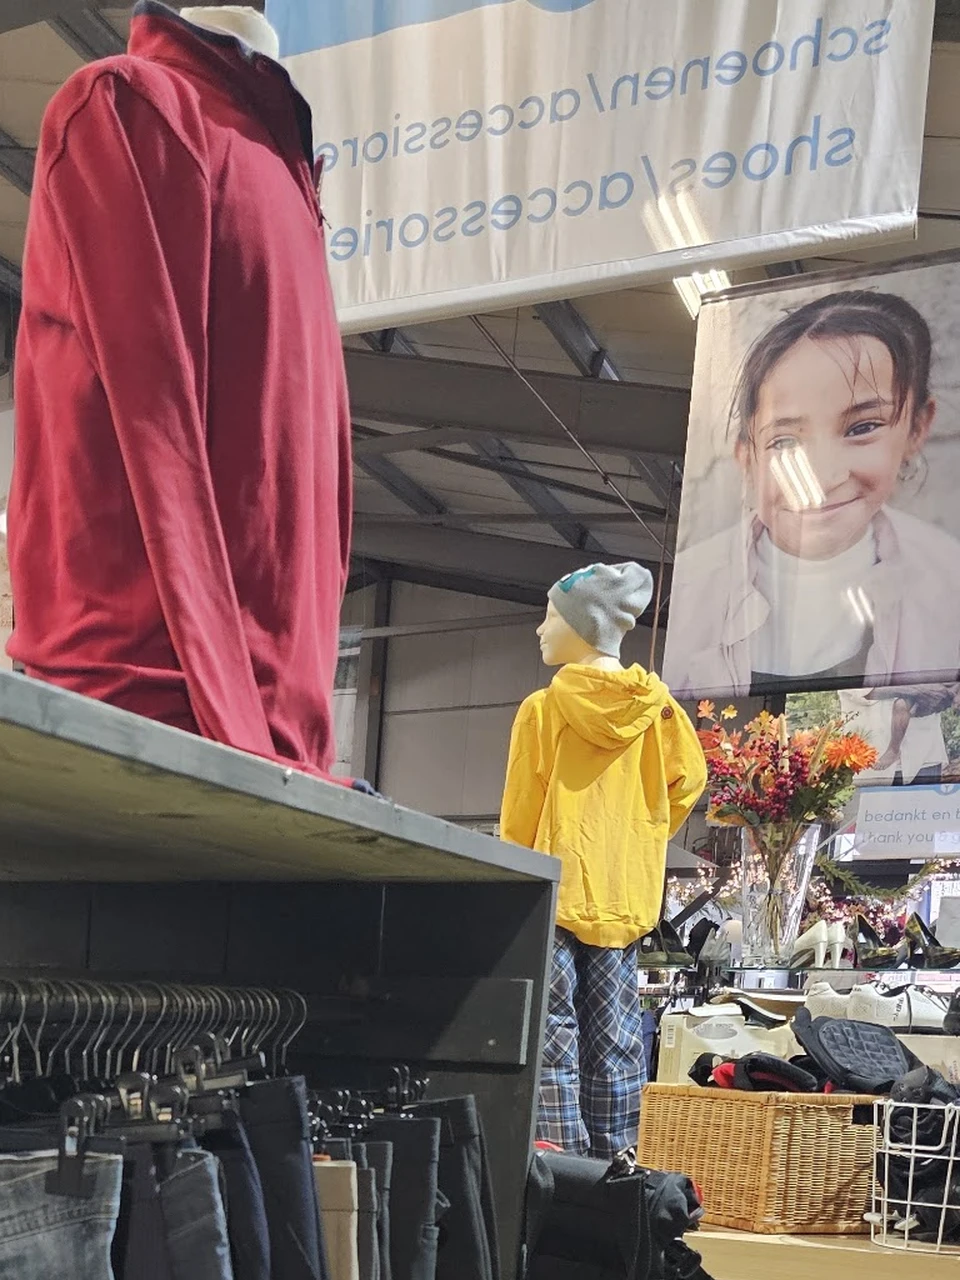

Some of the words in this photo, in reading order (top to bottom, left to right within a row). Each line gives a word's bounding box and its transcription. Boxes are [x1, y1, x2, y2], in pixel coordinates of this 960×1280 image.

[864, 807, 927, 822] bedankt
[932, 811, 951, 821] en
[907, 832, 935, 846] you
